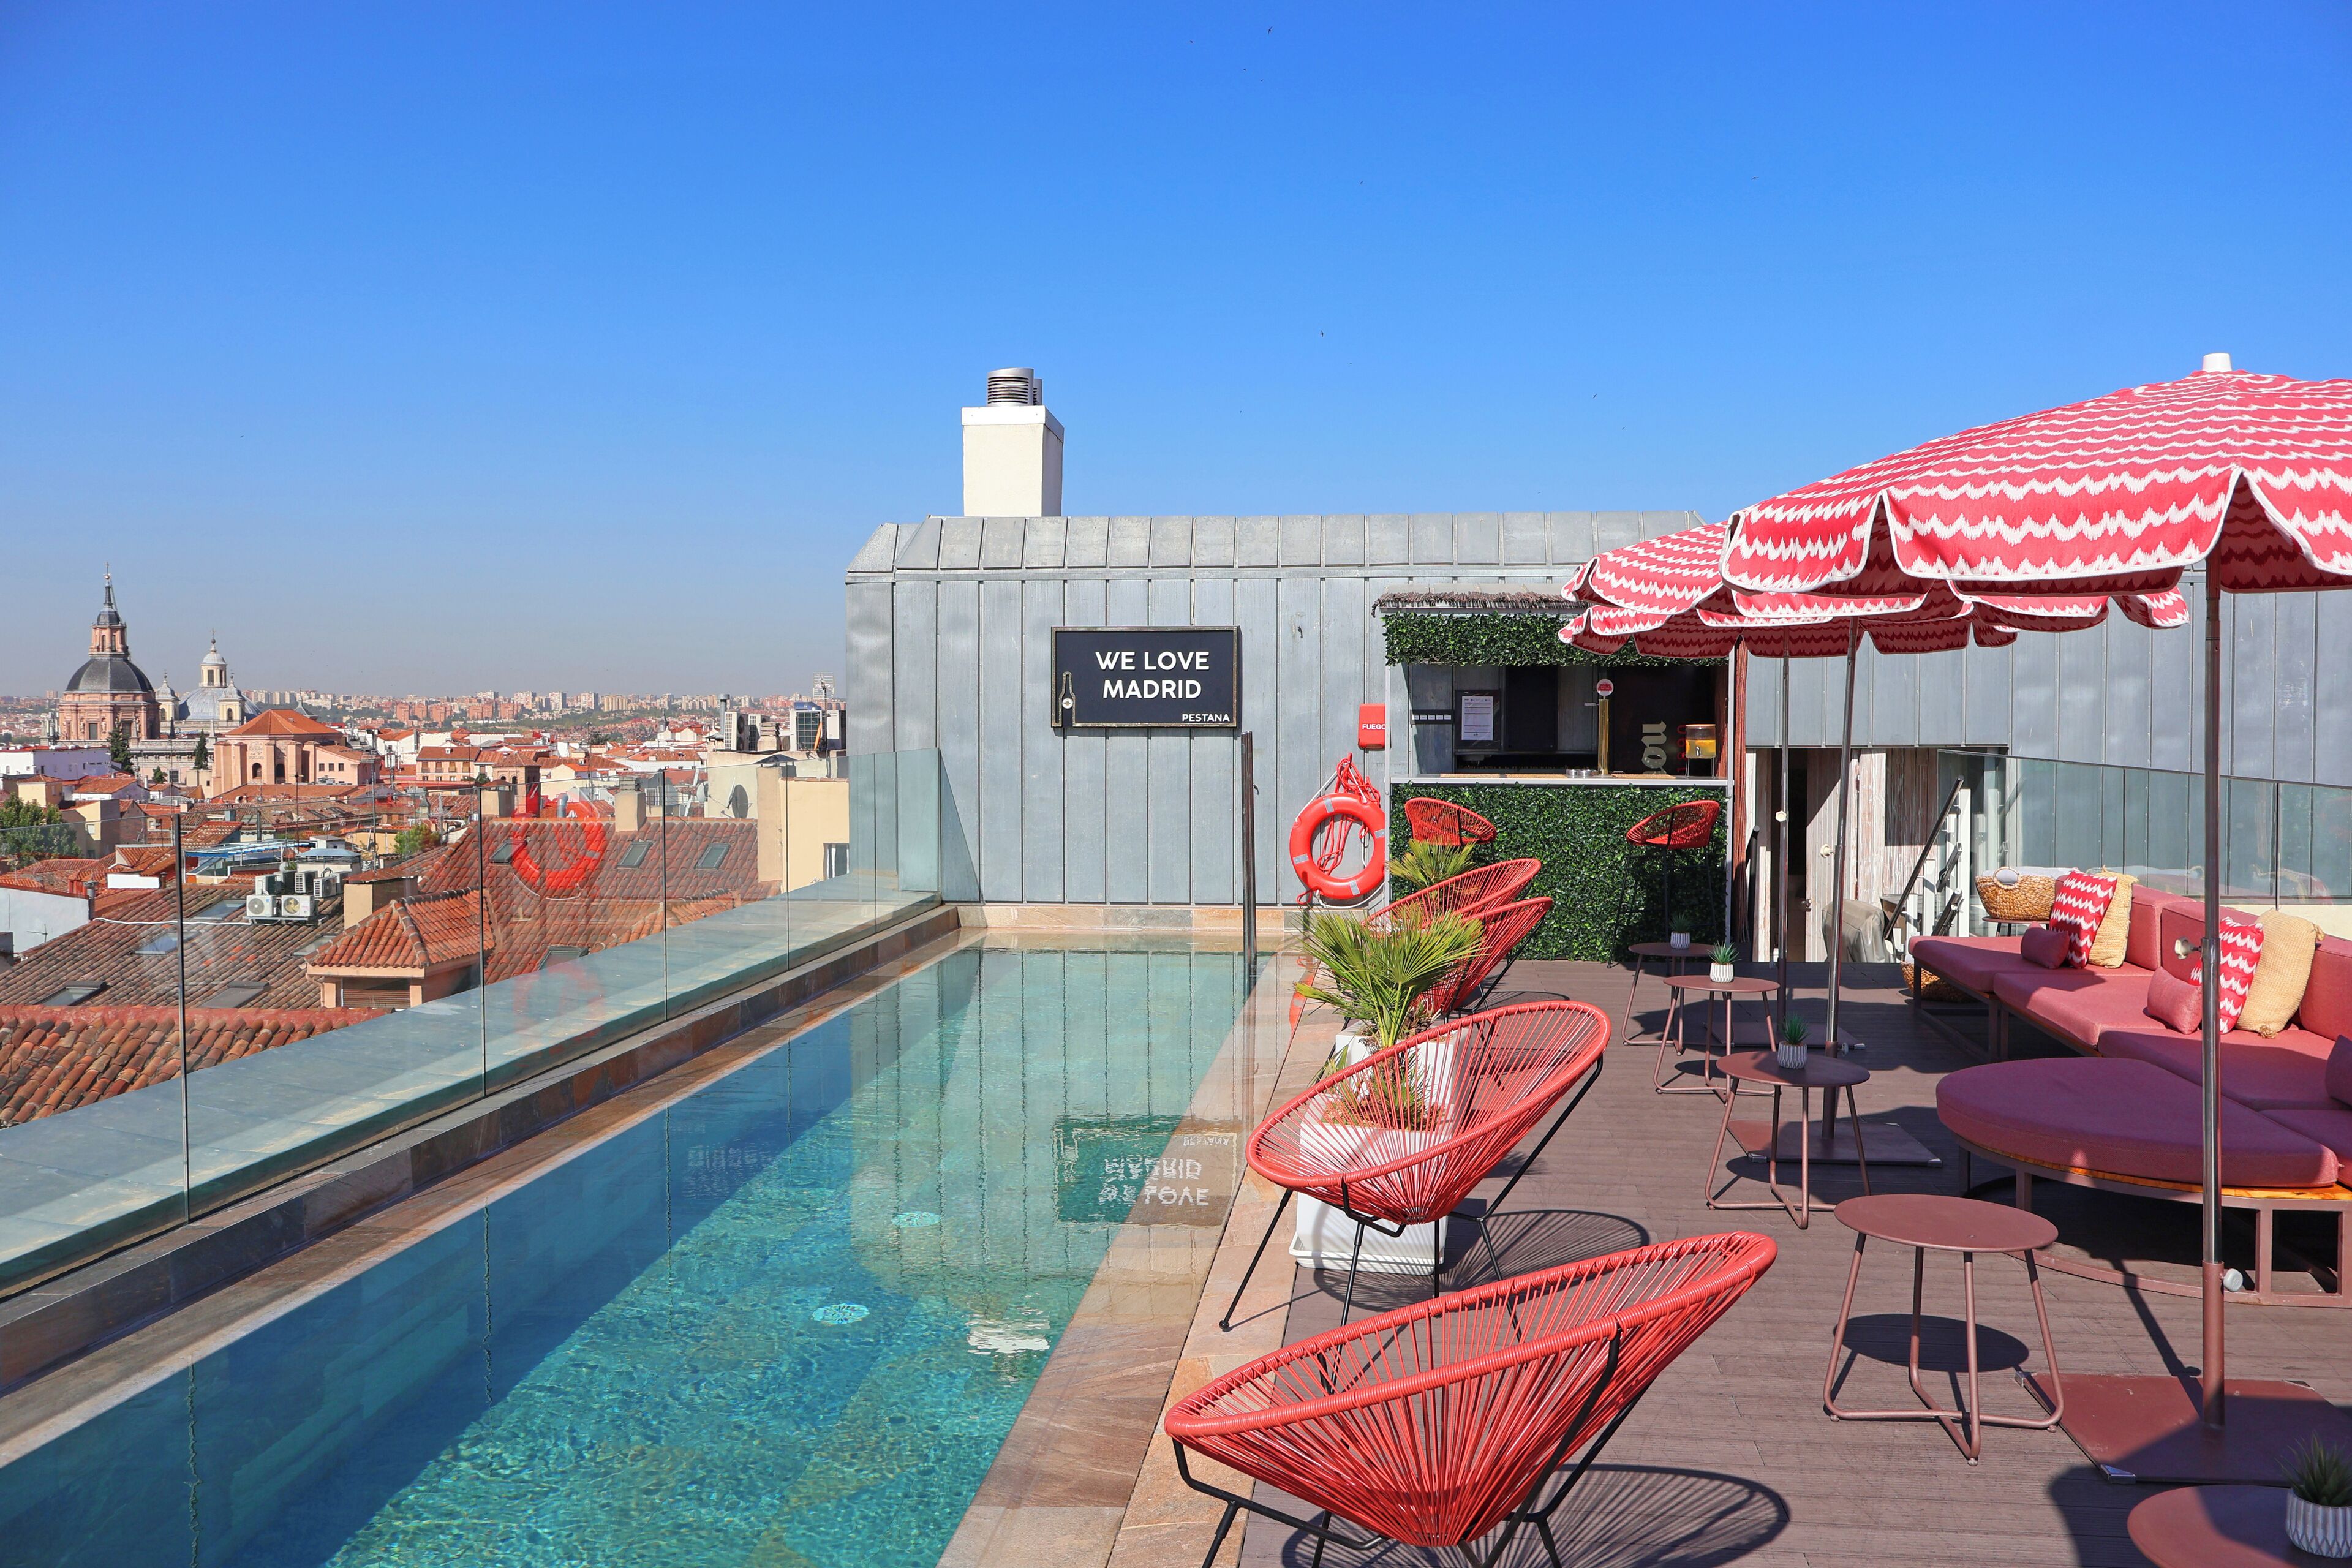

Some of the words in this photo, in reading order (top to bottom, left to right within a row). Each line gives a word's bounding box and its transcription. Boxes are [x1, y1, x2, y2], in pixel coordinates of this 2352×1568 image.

[1095, 651, 1136, 670] WE
[1144, 651, 1210, 670] LOVE
[1103, 680, 1202, 698] MADRID
[1182, 714, 1231, 722] PESTANA
[1642, 720, 1667, 774] ou
